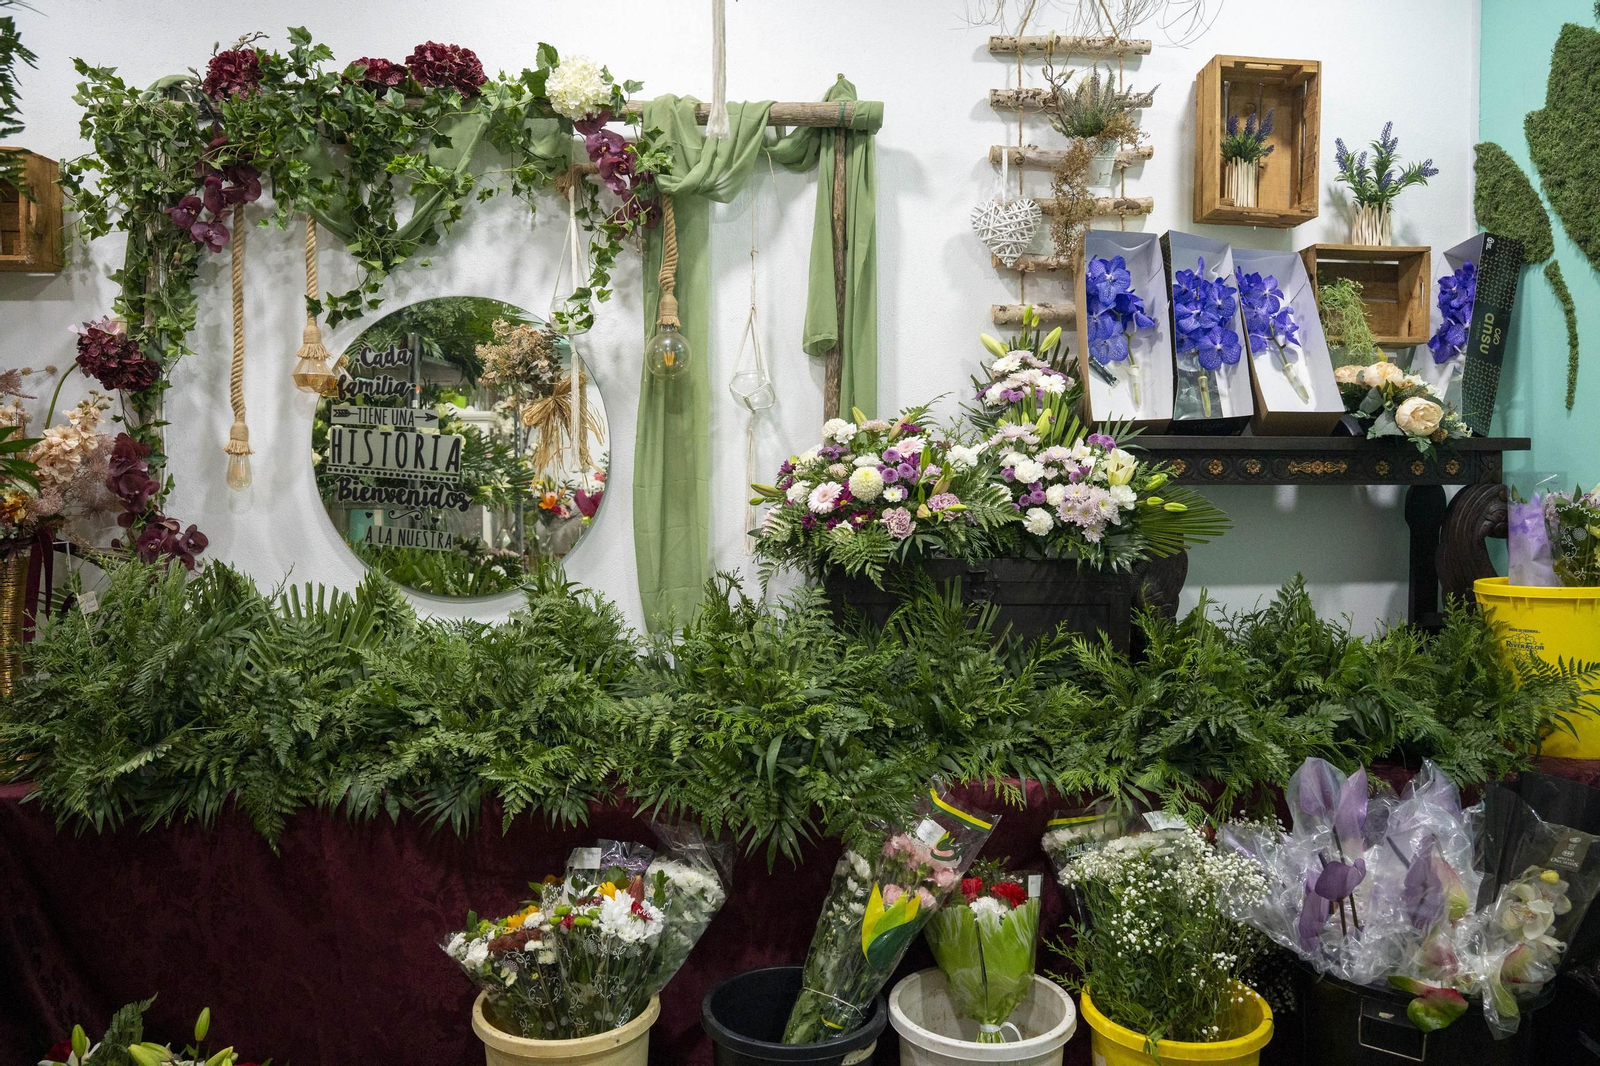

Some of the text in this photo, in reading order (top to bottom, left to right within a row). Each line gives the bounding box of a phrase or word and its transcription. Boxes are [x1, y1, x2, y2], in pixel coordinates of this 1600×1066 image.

[1479, 312, 1495, 355] ansu
[358, 344, 413, 369] Cada
[337, 374, 411, 401] familia
[357, 407, 415, 427] TIENE UNA
[331, 428, 461, 473] HISTORIA
[337, 476, 473, 512] Bienvenidos
[365, 526, 453, 549] A LA NUESTRA
